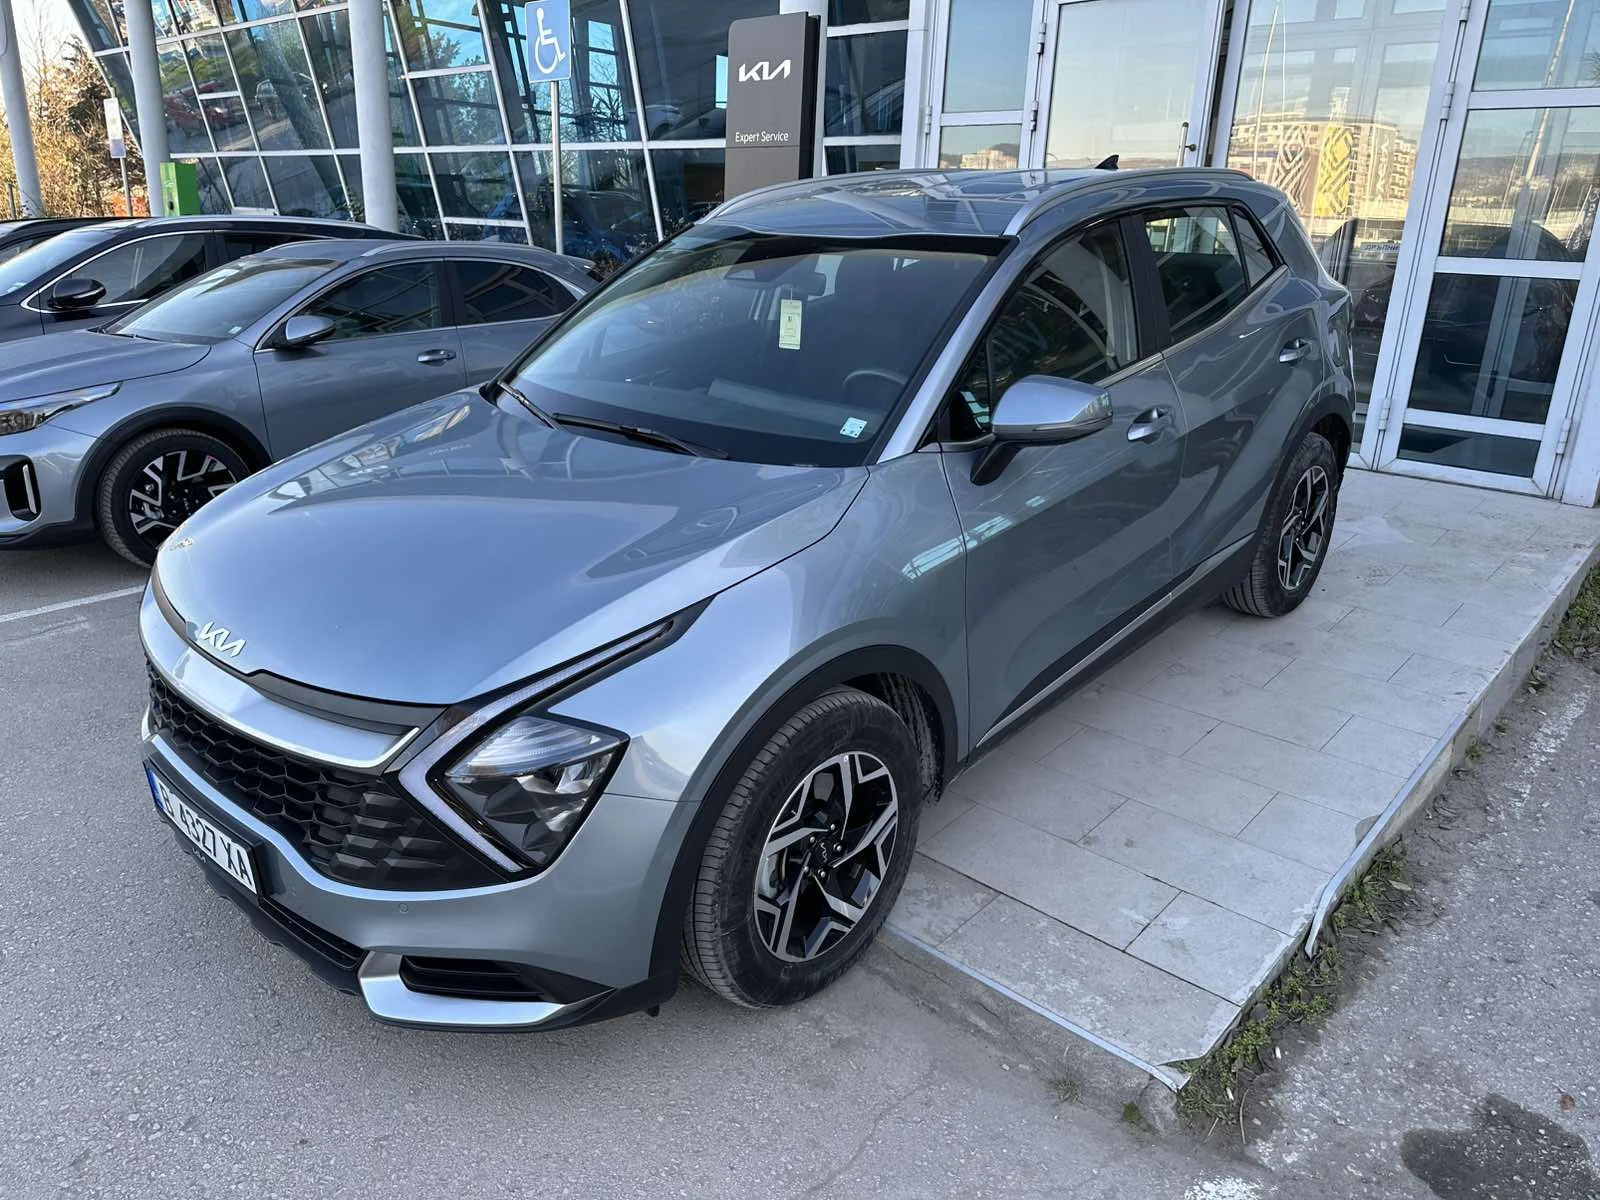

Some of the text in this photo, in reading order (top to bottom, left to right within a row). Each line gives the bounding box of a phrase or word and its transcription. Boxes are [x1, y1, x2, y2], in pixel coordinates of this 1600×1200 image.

[738, 59, 791, 82] KIA
[735, 131, 789, 144] Expert Service
[199, 621, 247, 658] KIA
[159, 782, 254, 887] B 4327 XA
